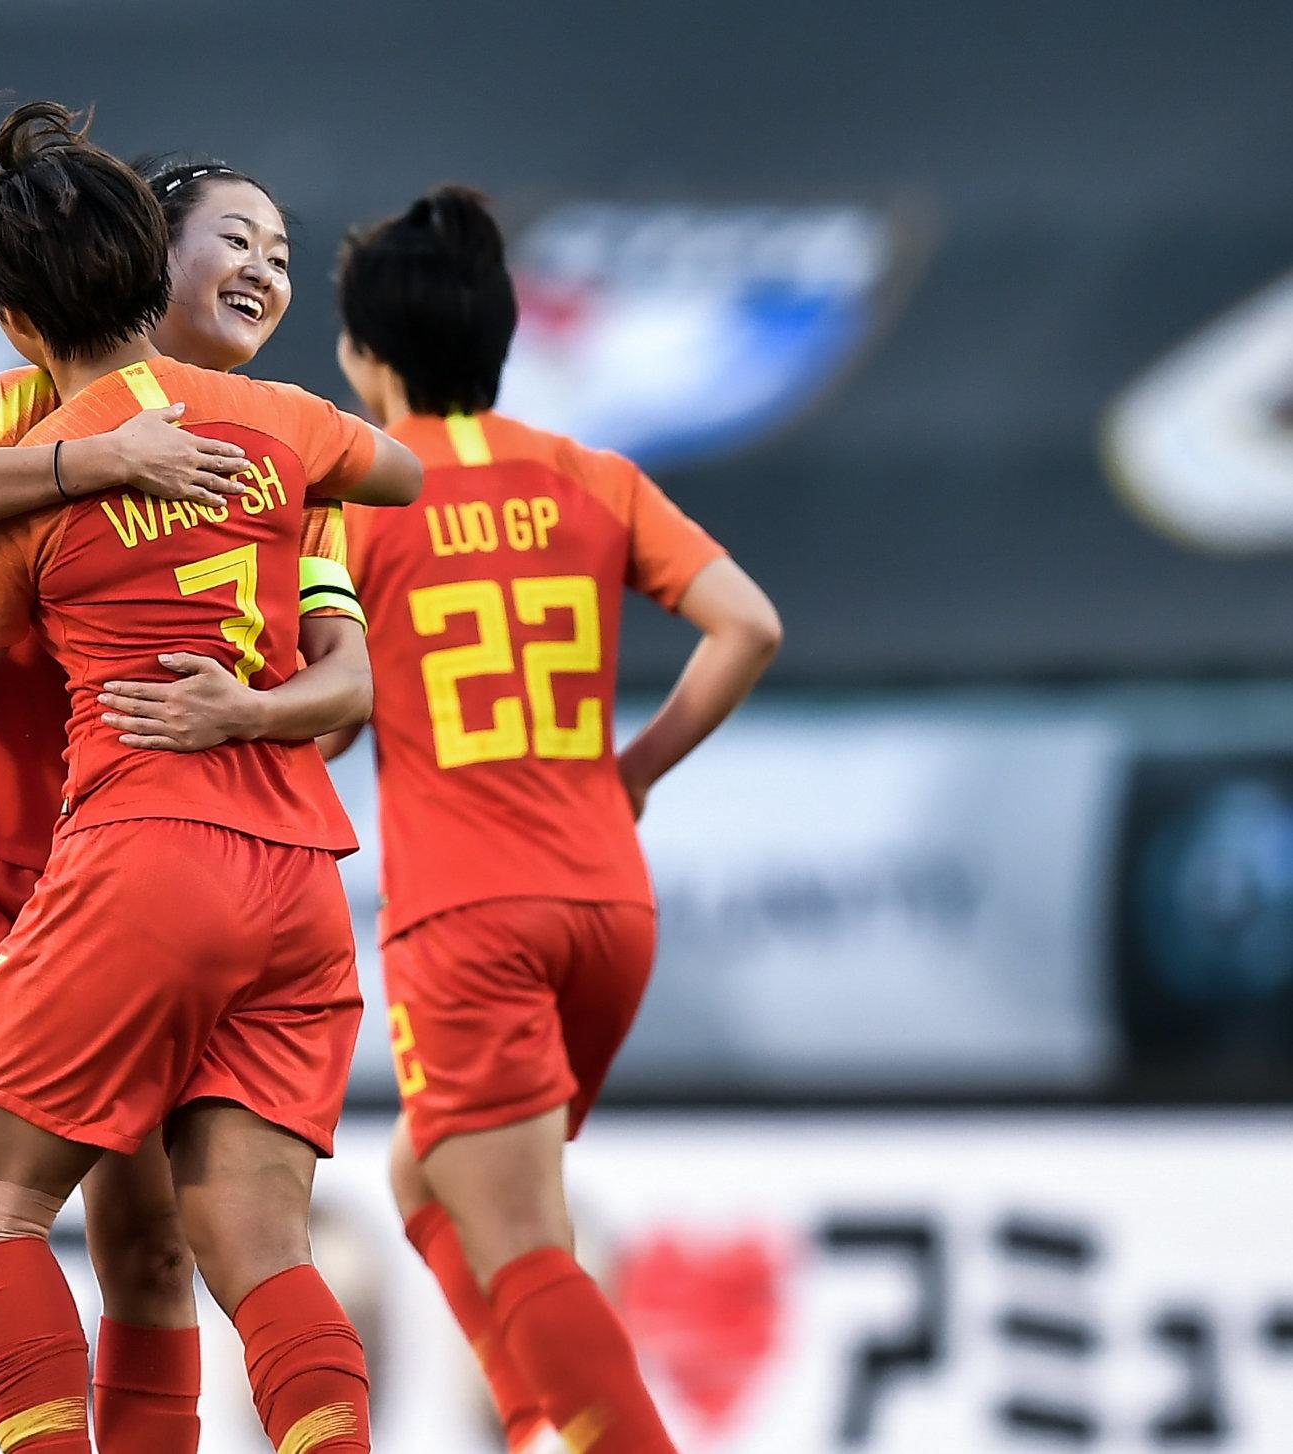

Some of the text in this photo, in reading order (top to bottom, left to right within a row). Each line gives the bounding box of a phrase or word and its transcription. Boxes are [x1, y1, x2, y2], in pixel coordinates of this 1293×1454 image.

[230, 455, 287, 515] SH
[425, 496, 560, 557] LUO GP
[173, 542, 265, 688] 7
[408, 575, 603, 769] 22
